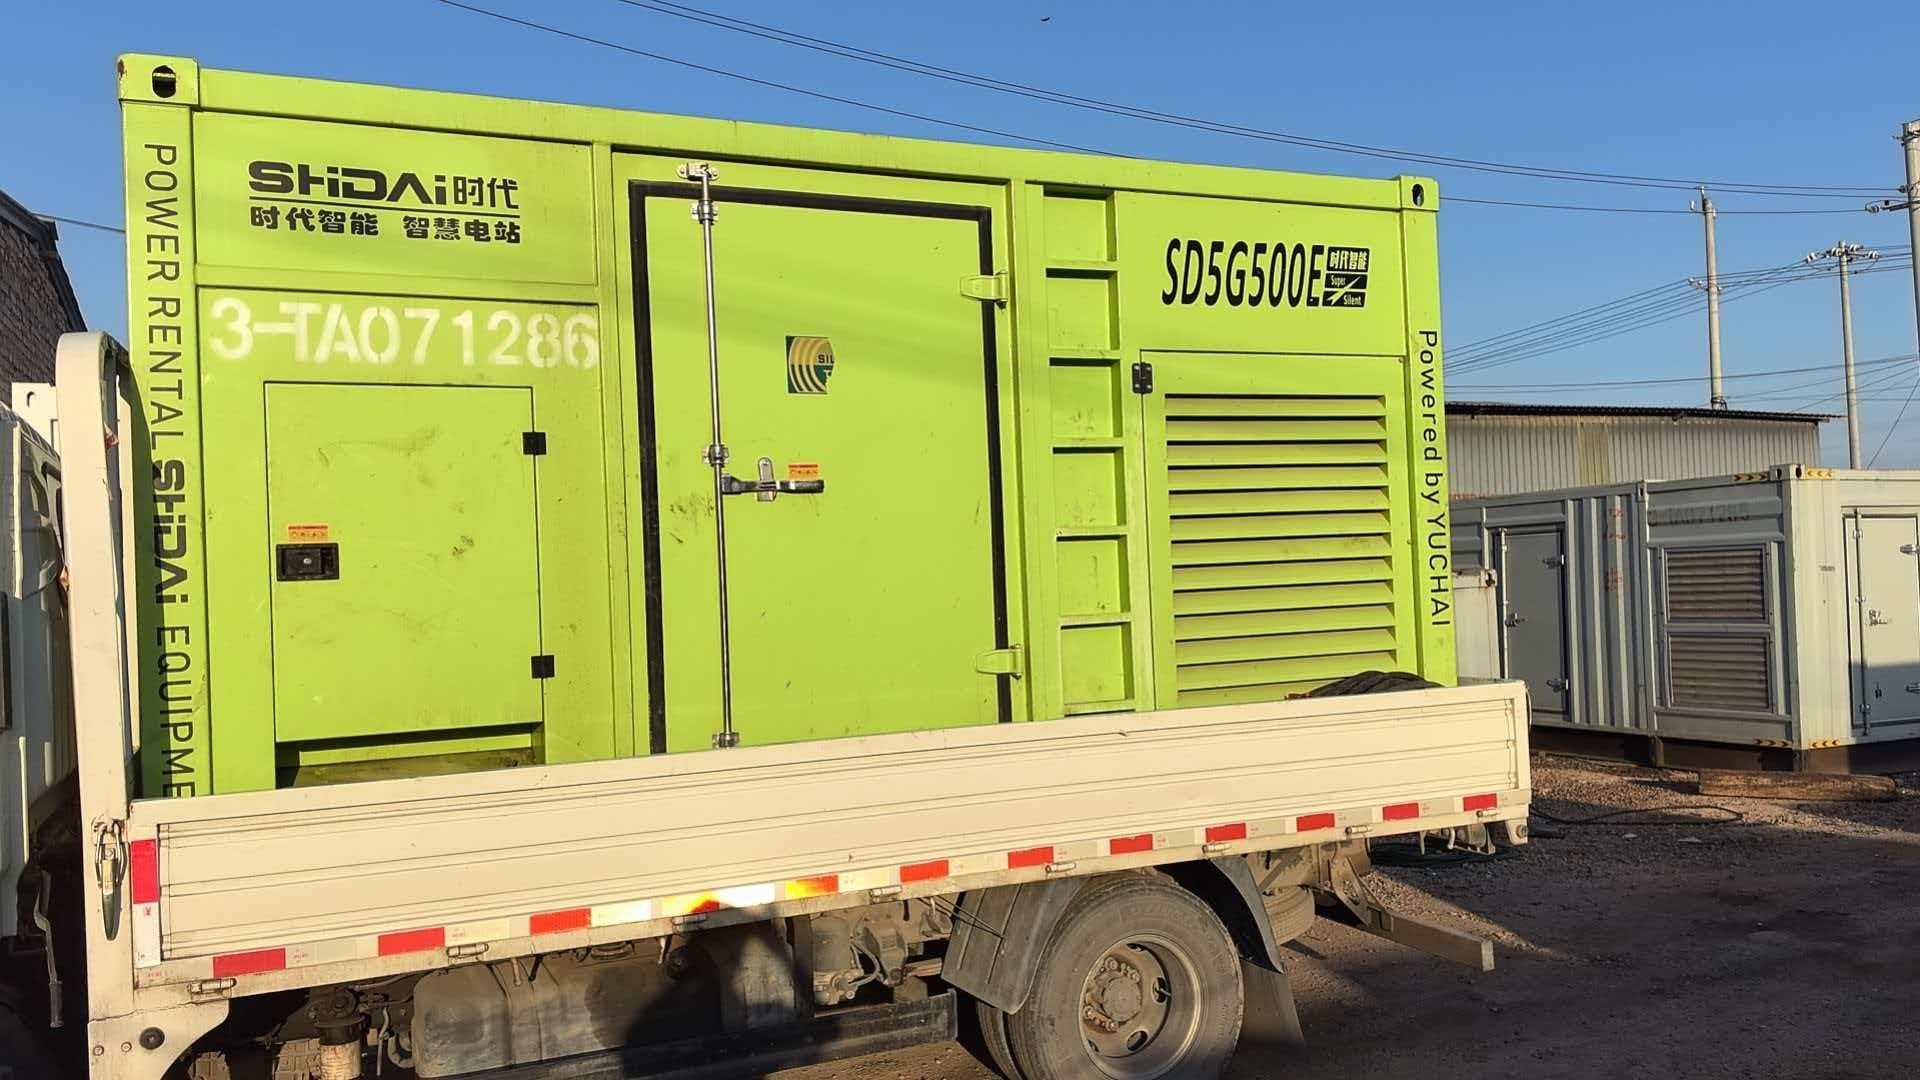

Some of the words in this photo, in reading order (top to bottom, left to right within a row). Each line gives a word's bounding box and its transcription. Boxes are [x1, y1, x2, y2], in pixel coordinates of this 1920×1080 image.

[144, 144, 180, 281] POWER
[250, 206, 379, 236] 时代智能
[402, 215, 520, 244] 智慧电站
[453, 176, 519, 209] 时代
[1161, 237, 1325, 307] SD5G500E
[209, 297, 599, 370] 3-TA071286
[148, 297, 183, 450] RENTAL
[1418, 330, 1443, 461] Powered
[1421, 472, 1443, 504] by
[1427, 513, 1450, 625] YUCHAI
